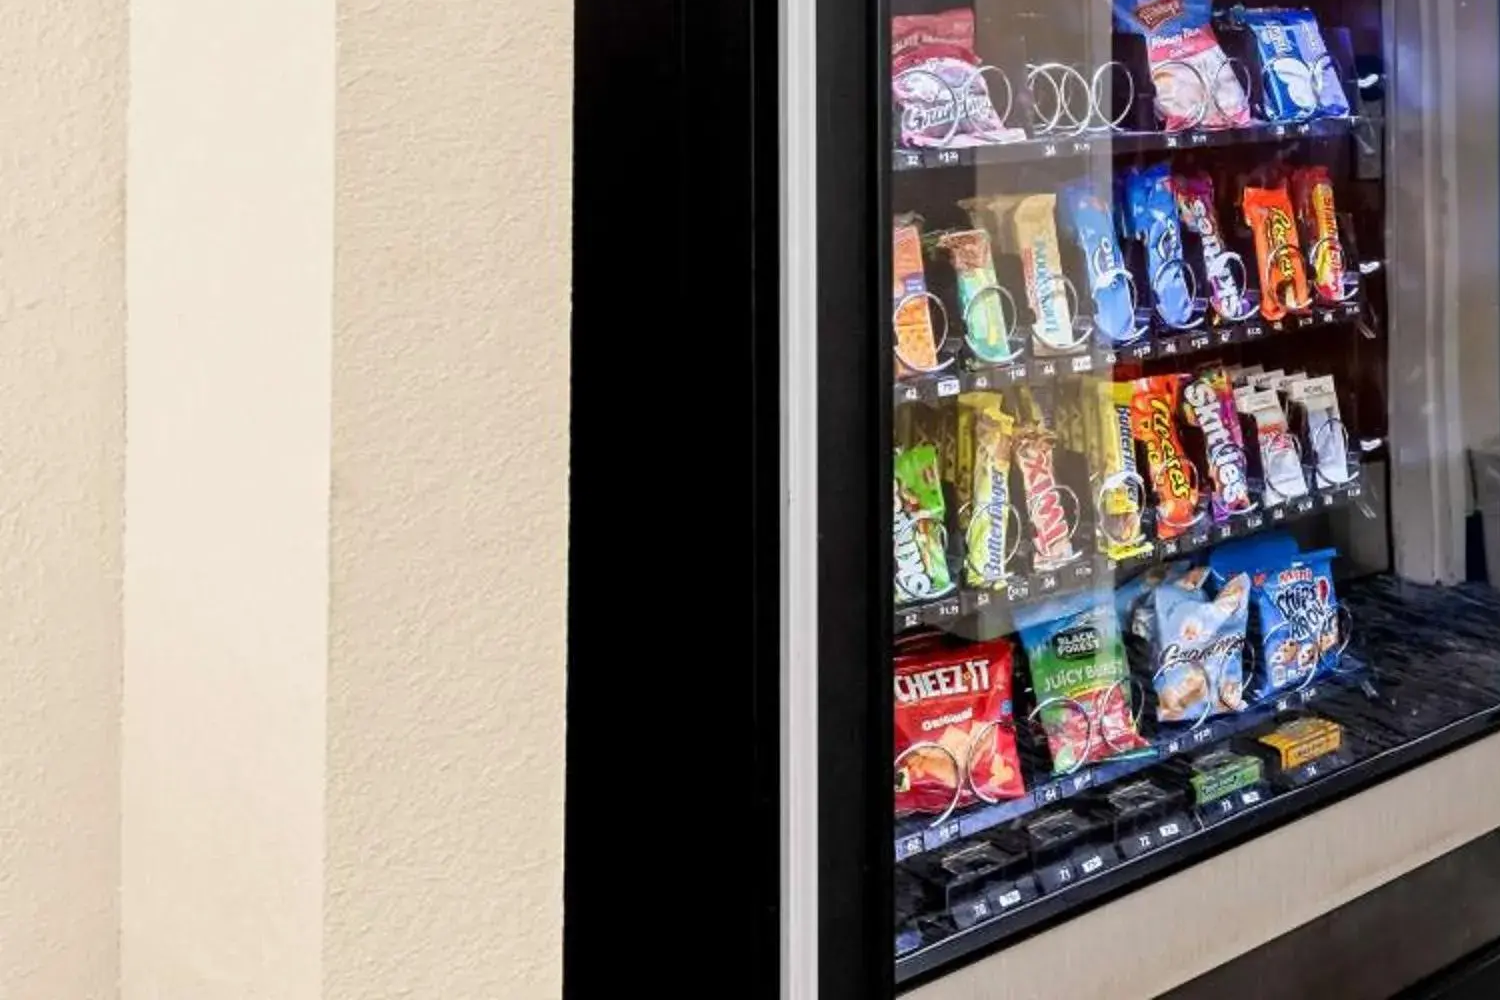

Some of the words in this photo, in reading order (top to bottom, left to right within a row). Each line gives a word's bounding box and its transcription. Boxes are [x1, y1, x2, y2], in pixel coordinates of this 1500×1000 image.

[1184, 383, 1241, 505] Skittles
[983, 468, 1005, 578] Butterfinger
[1056, 631, 1095, 645] BLACK
[1056, 639, 1101, 657] FOREST
[1043, 667, 1084, 692] JUICY
